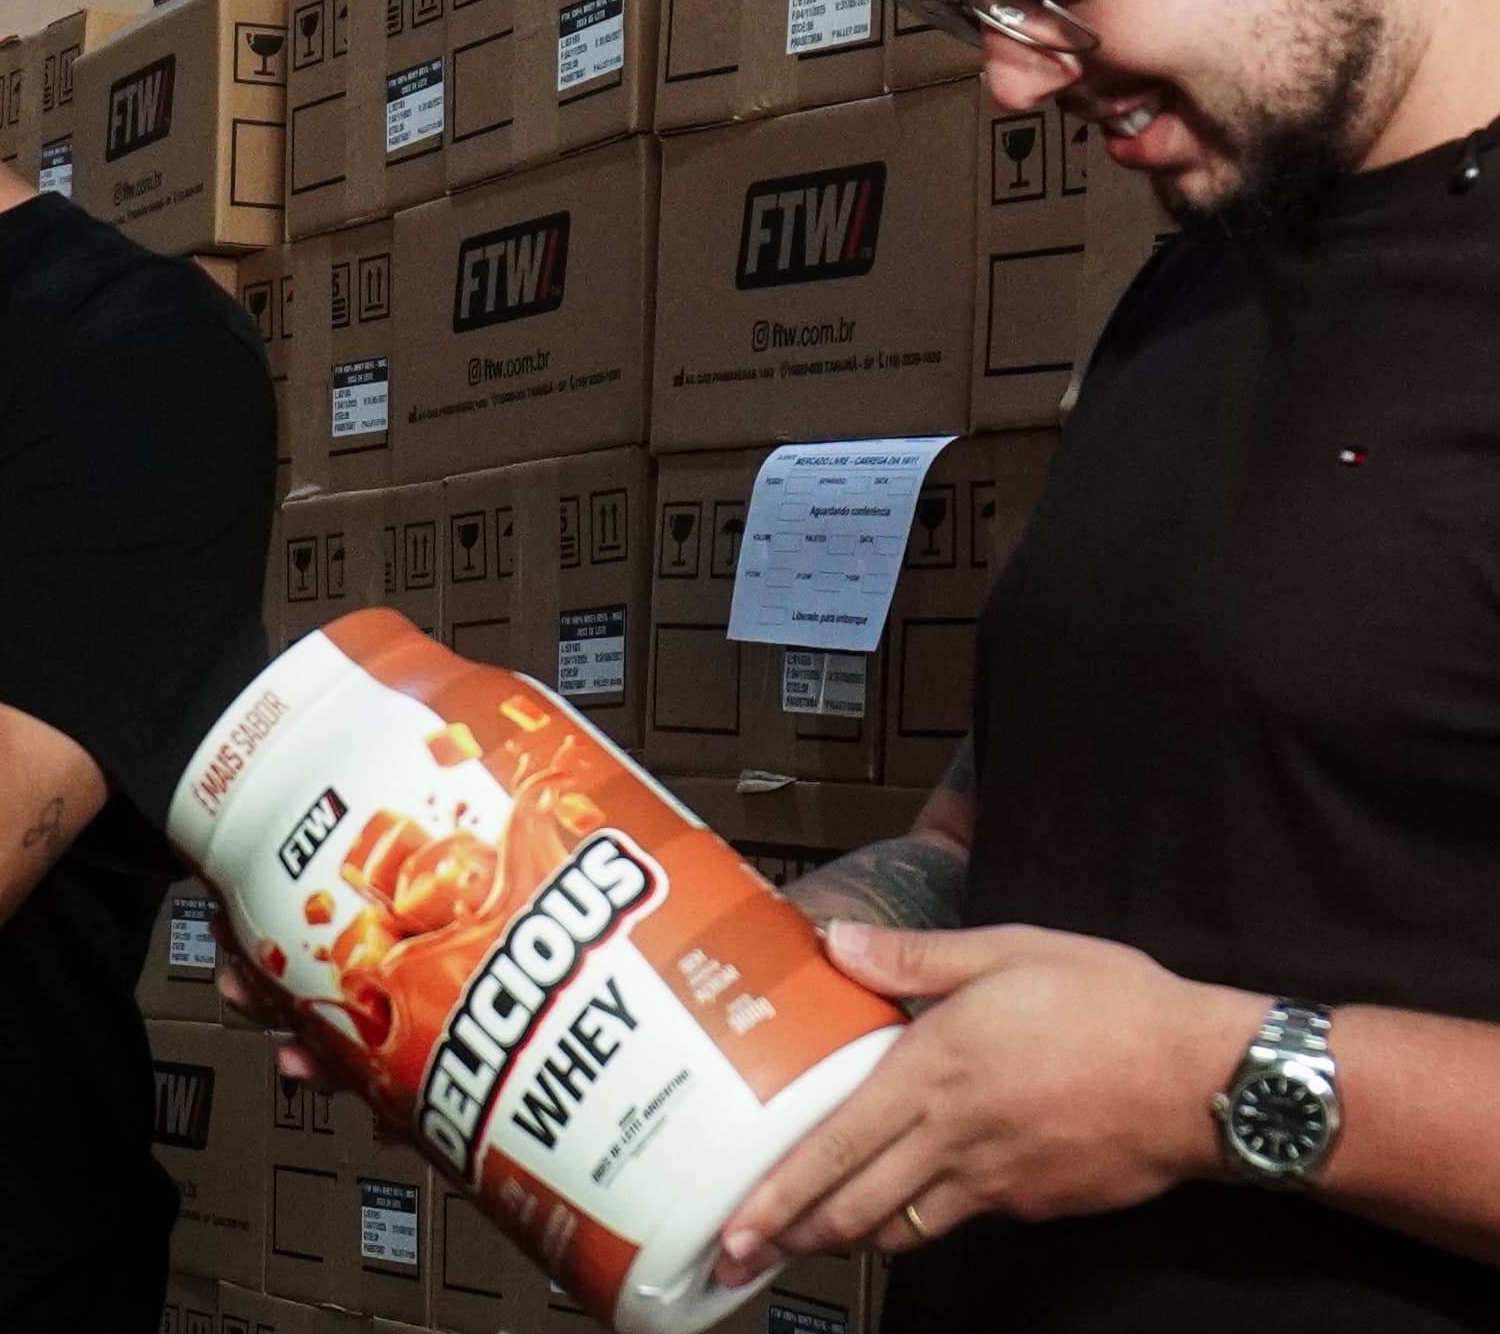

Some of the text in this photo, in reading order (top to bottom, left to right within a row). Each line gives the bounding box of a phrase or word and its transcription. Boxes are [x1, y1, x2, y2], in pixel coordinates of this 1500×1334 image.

[111, 71, 161, 150] FTW
[745, 181, 857, 275] FTW
[460, 229, 548, 319] FTW
[484, 347, 551, 380] ftw.com.br
[772, 318, 855, 347] ftw.com.br
[796, 456, 829, 466] MERCADO
[829, 456, 849, 465] LIVRE
[855, 456, 888, 465] CARREGA
[889, 456, 901, 464] DIA
[809, 505, 891, 517] Aguardando conferência
[792, 612, 868, 625] Liberado para embarque
[200, 690, 289, 802] MAIS SABOR
[280, 796, 340, 877] FTW
[422, 838, 648, 1169] DELICIOUS
[512, 976, 638, 1150] WHEY
